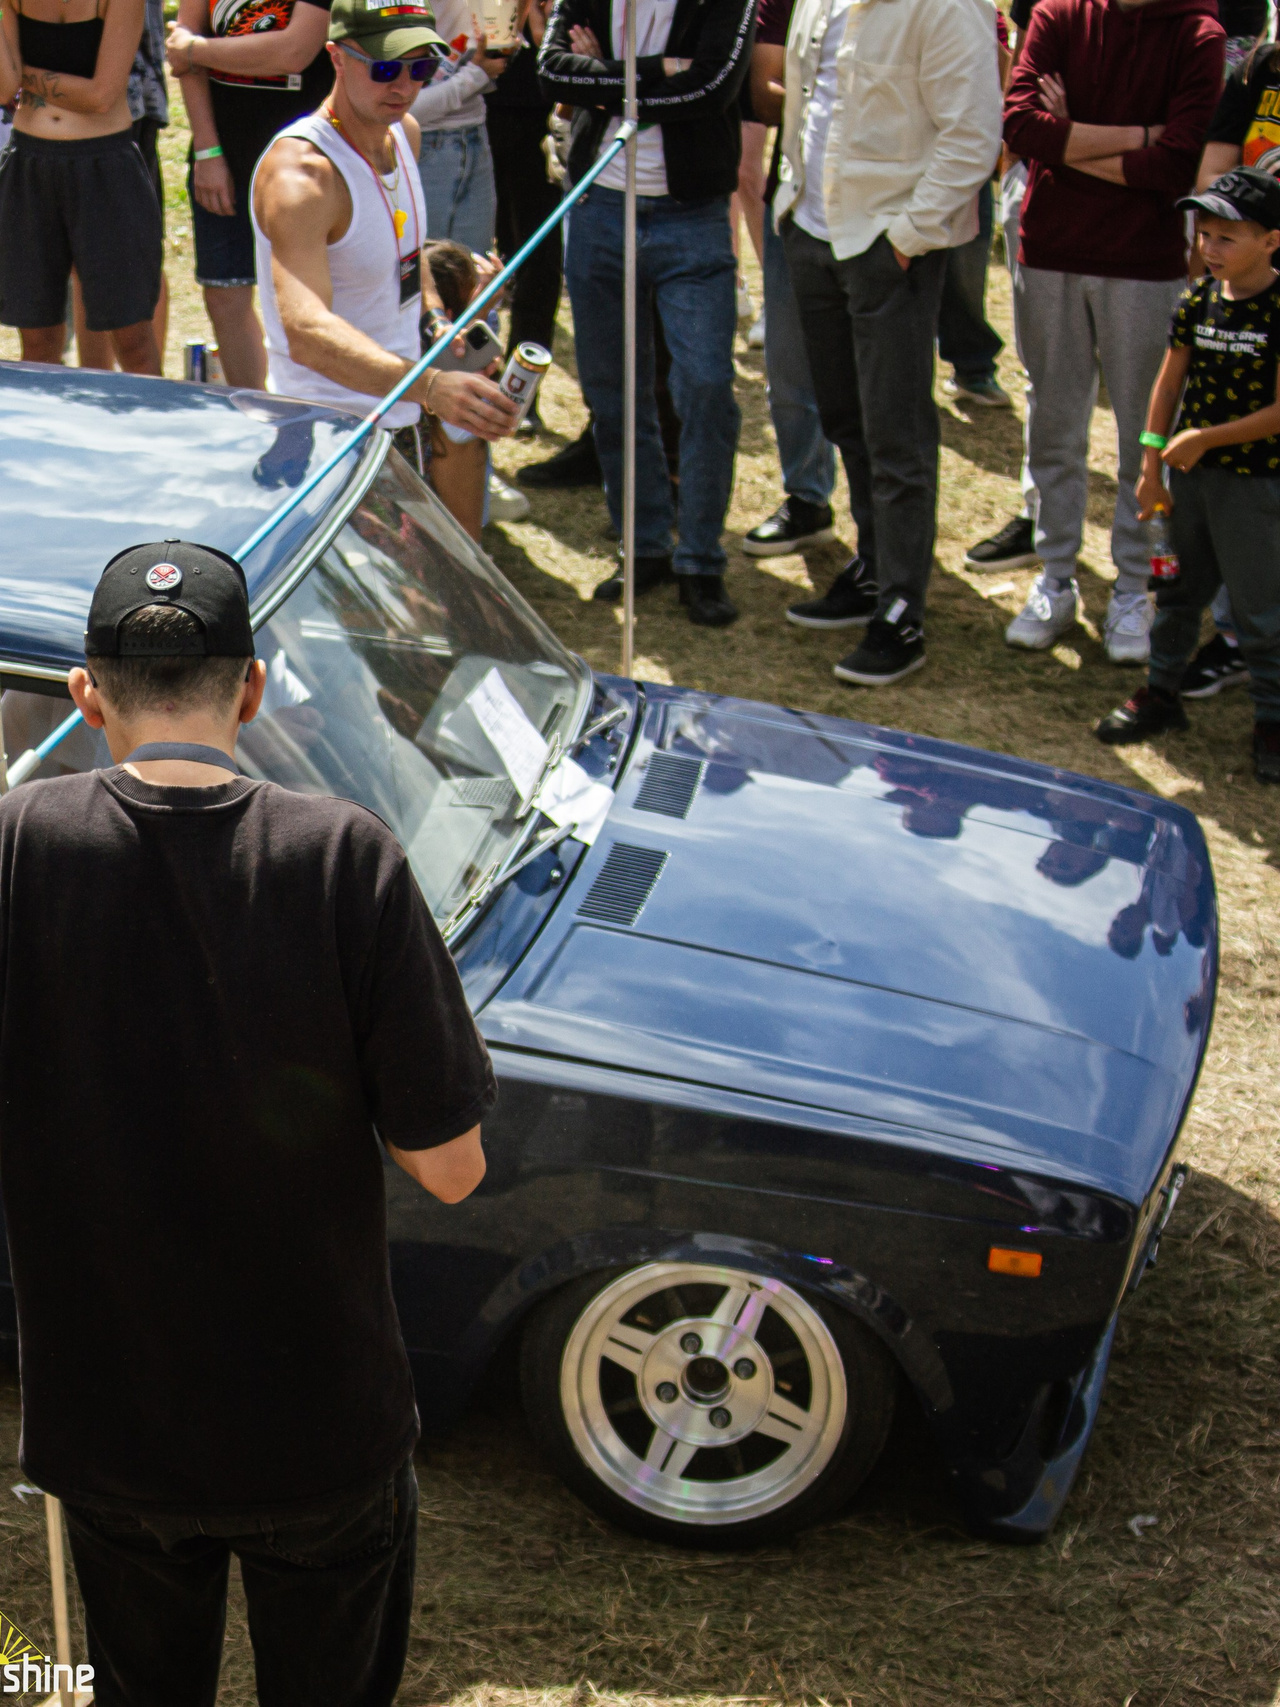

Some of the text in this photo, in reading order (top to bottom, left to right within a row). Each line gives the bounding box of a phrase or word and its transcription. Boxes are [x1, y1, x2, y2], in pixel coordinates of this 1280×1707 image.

[731, 36, 745, 60] KORS
[572, 76, 595, 85] KORS
[705, 60, 736, 91] MICHAEL
[682, 88, 706, 102] KORS
